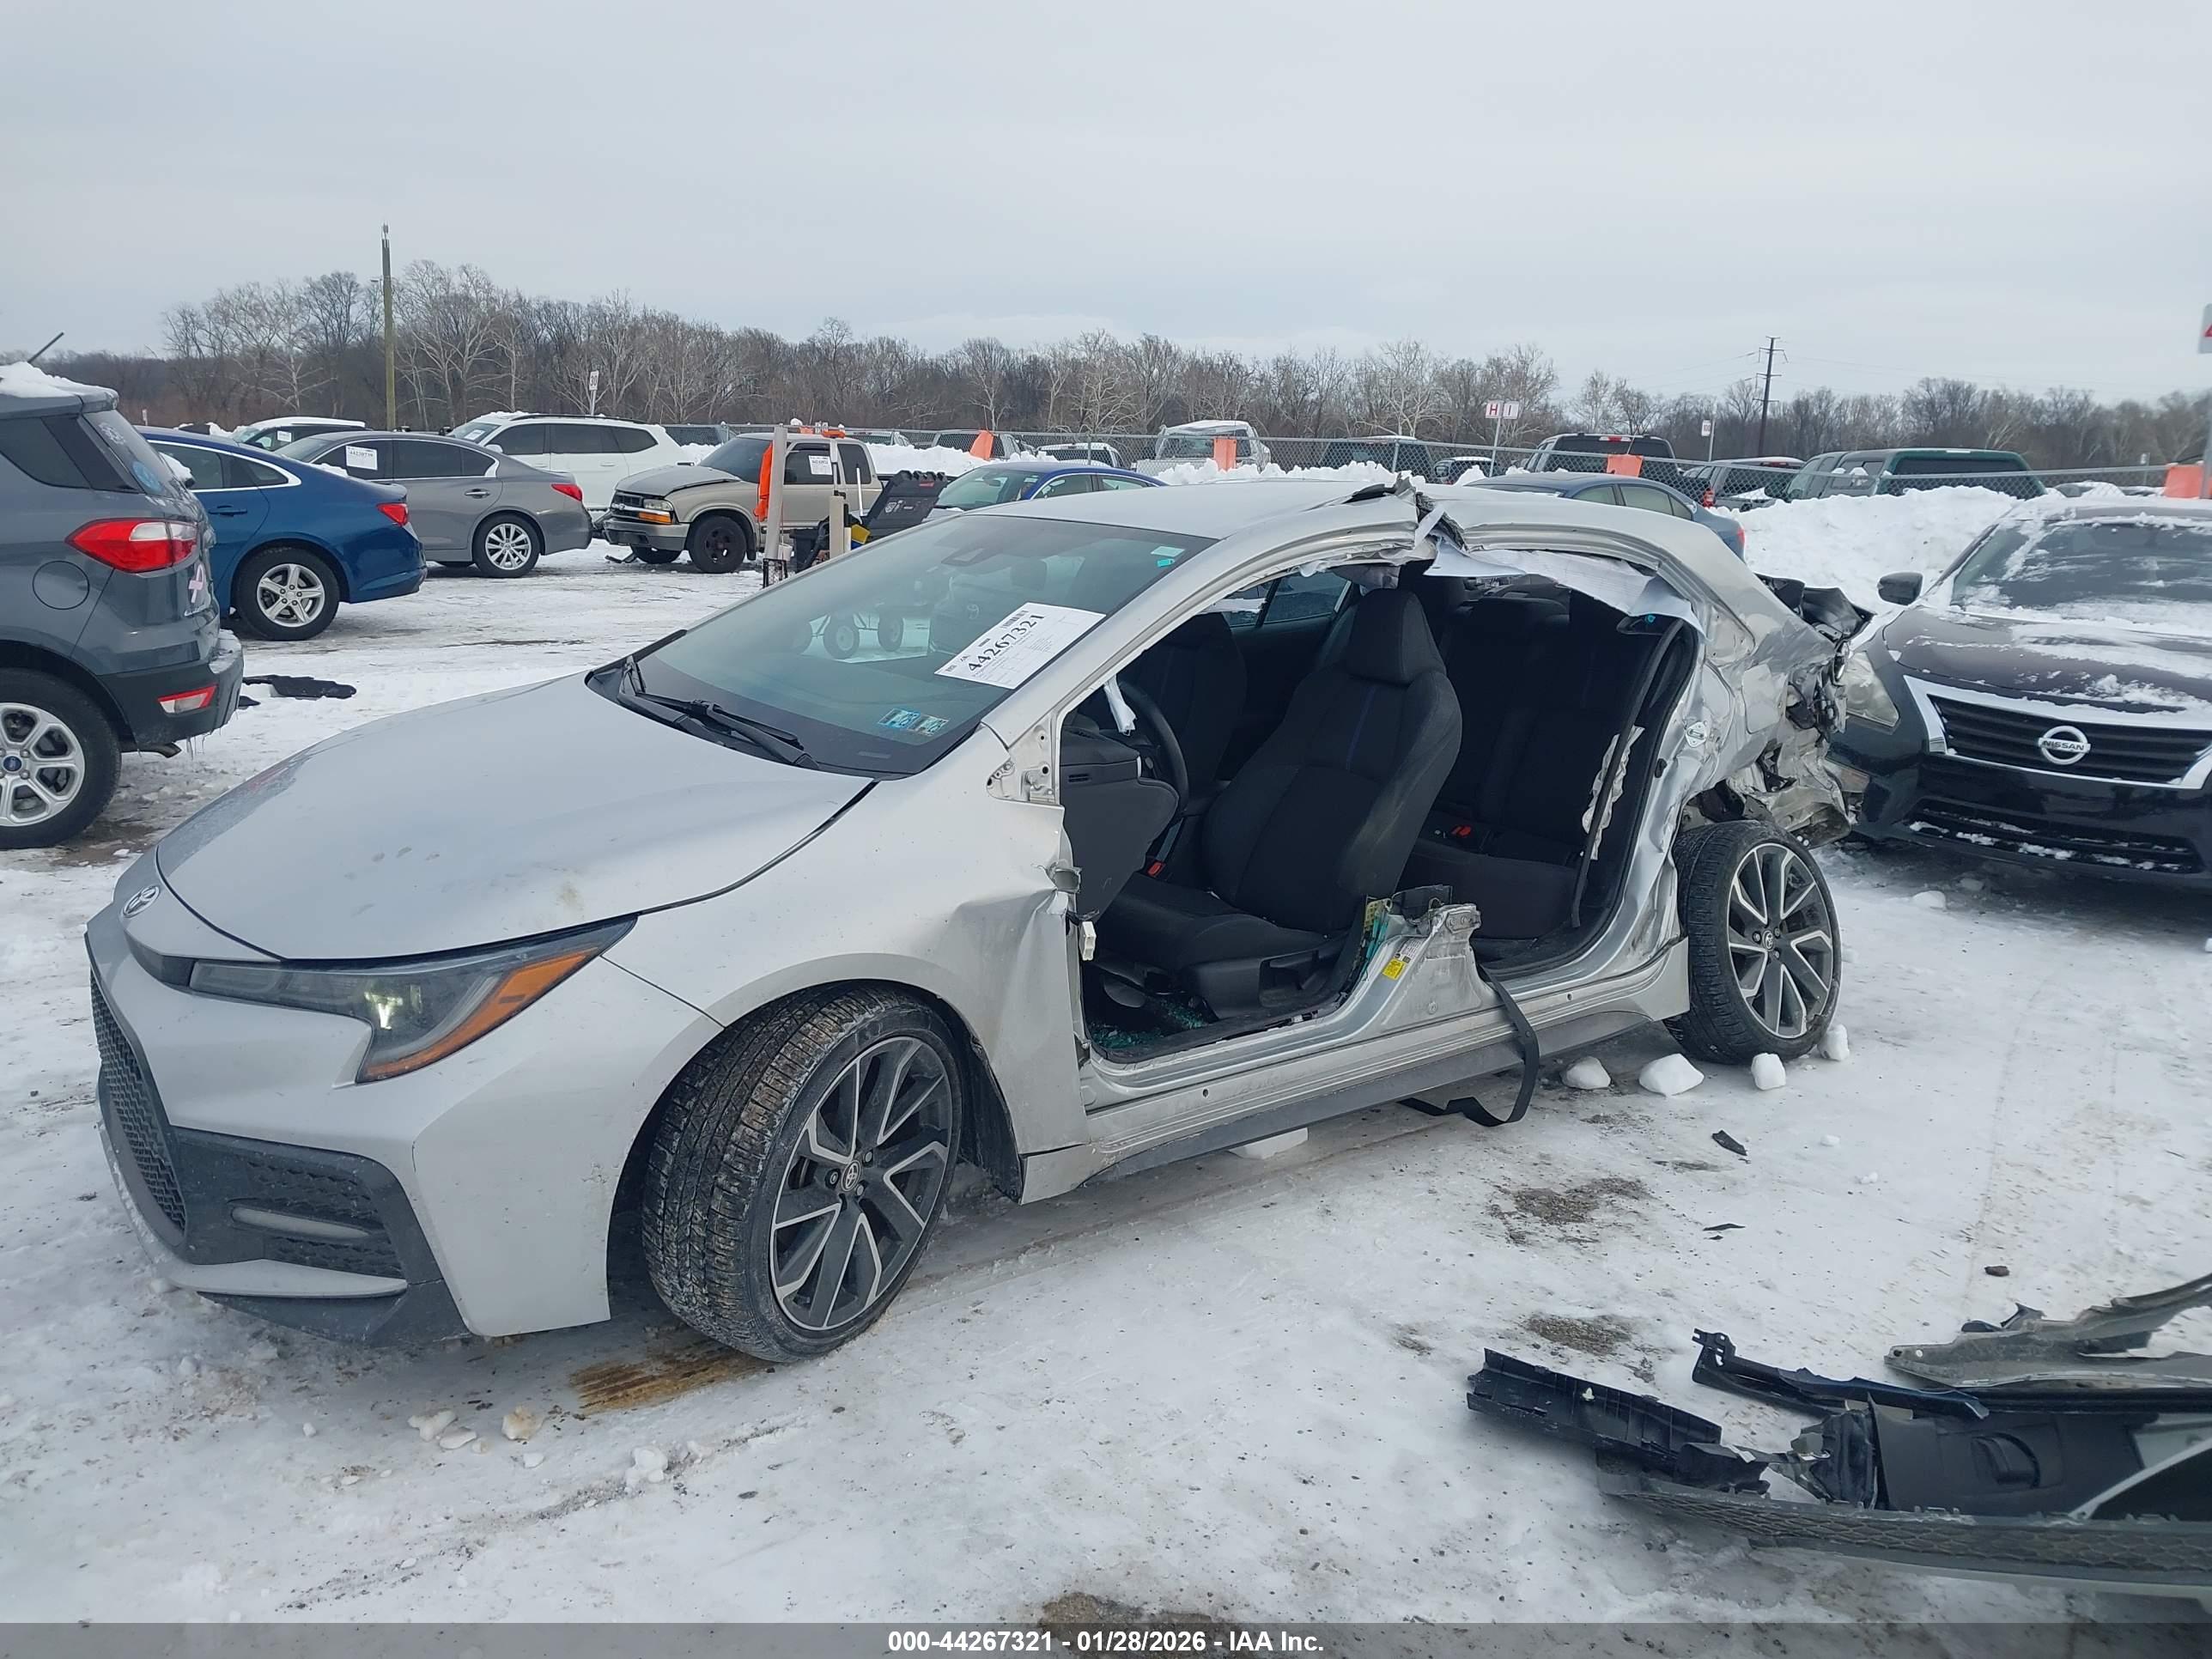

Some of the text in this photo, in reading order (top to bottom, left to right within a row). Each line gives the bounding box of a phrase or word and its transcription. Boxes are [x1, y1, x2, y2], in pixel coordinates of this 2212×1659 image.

[1489, 404, 1498, 416] H
[1507, 404, 1512, 416] I
[968, 614, 1045, 672] 44267321
[2041, 740, 2085, 751] NISSAN
